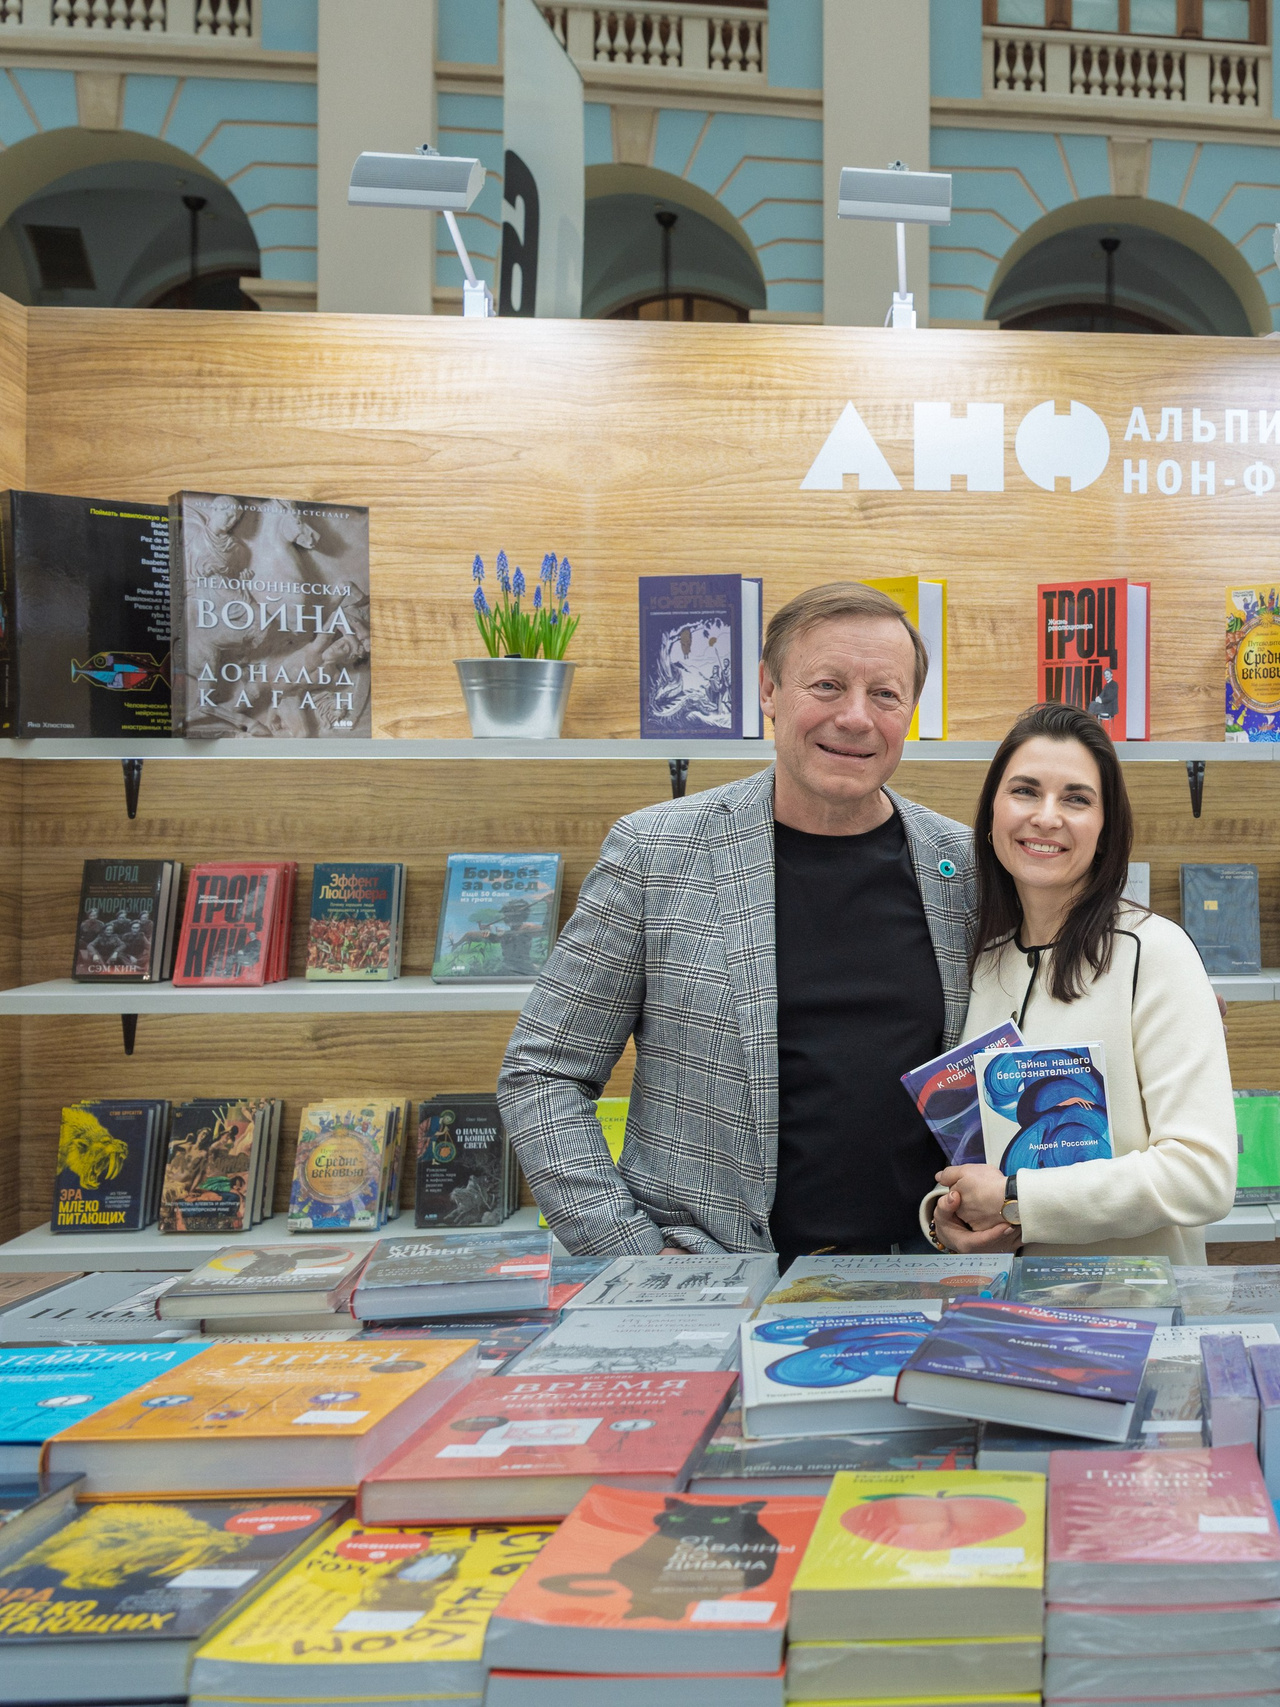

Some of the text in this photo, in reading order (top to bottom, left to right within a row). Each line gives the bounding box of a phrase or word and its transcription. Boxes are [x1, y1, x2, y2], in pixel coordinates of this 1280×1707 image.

[196, 577, 351, 597] ПЕЛОПОННЕССКАЯ
[196, 595, 356, 635] ВОЙНА
[1043, 587, 1118, 670] ТРОЦ
[197, 662, 355, 686] ДОНАЛЬД
[199, 688, 354, 710] КАГАН
[105, 865, 139, 882] ОТРЯД
[463, 867, 540, 881] Борьба
[329, 873, 379, 890] Эффект
[461, 881, 539, 892] за обед
[319, 885, 387, 903] Люцифера
[84, 897, 153, 914] ОТМОРОЗКОВ
[195, 874, 269, 932] ТРОЦ
[88, 965, 137, 973] СЭМ КИН
[1015, 1056, 1090, 1069] Тайны нашего
[996, 1066, 1091, 1081] бессознательного
[937, 1081, 945, 1089] к
[462, 1127, 497, 1135] НАЧАЛАХ
[464, 1135, 495, 1145] КОНЦАХ
[1028, 1139, 1099, 1152] Андрей Россохин
[315, 1155, 364, 1169] Средне-
[311, 1167, 364, 1179] вековью
[59, 1188, 82, 1201] ЭРА
[58, 1200, 99, 1213] МЛЕКО
[57, 1211, 126, 1225] ПИТАЮЩИХ
[386, 1246, 476, 1259] ЖИВЫЕ
[389, 1243, 433, 1252] КАК
[833, 1261, 998, 1269] МЕГАФАУНЫ
[452, 1322, 496, 1330] Стюарт
[809, 1315, 925, 1325] Тайны нашего
[819, 1349, 915, 1359] Андрей Россо
[1008, 1338, 1126, 1359] Андрей Россохин
[0, 1350, 177, 1366] ТЕМАТИКА
[232, 1352, 403, 1366] ИГРЫ
[927, 1361, 979, 1375] Практика
[511, 1379, 690, 1393] ВРЕМЯ
[501, 1390, 683, 1401] ПЕРЕМЕННЫХ
[1086, 1469, 1233, 1483] Парадокс
[680, 1535, 715, 1546] ОТ
[675, 1543, 797, 1554] САВАННЫ
[668, 1550, 710, 1562] ДО
[662, 1560, 768, 1571] ДИВАНА
[0, 1612, 176, 1634] ТАЮЩИХ
